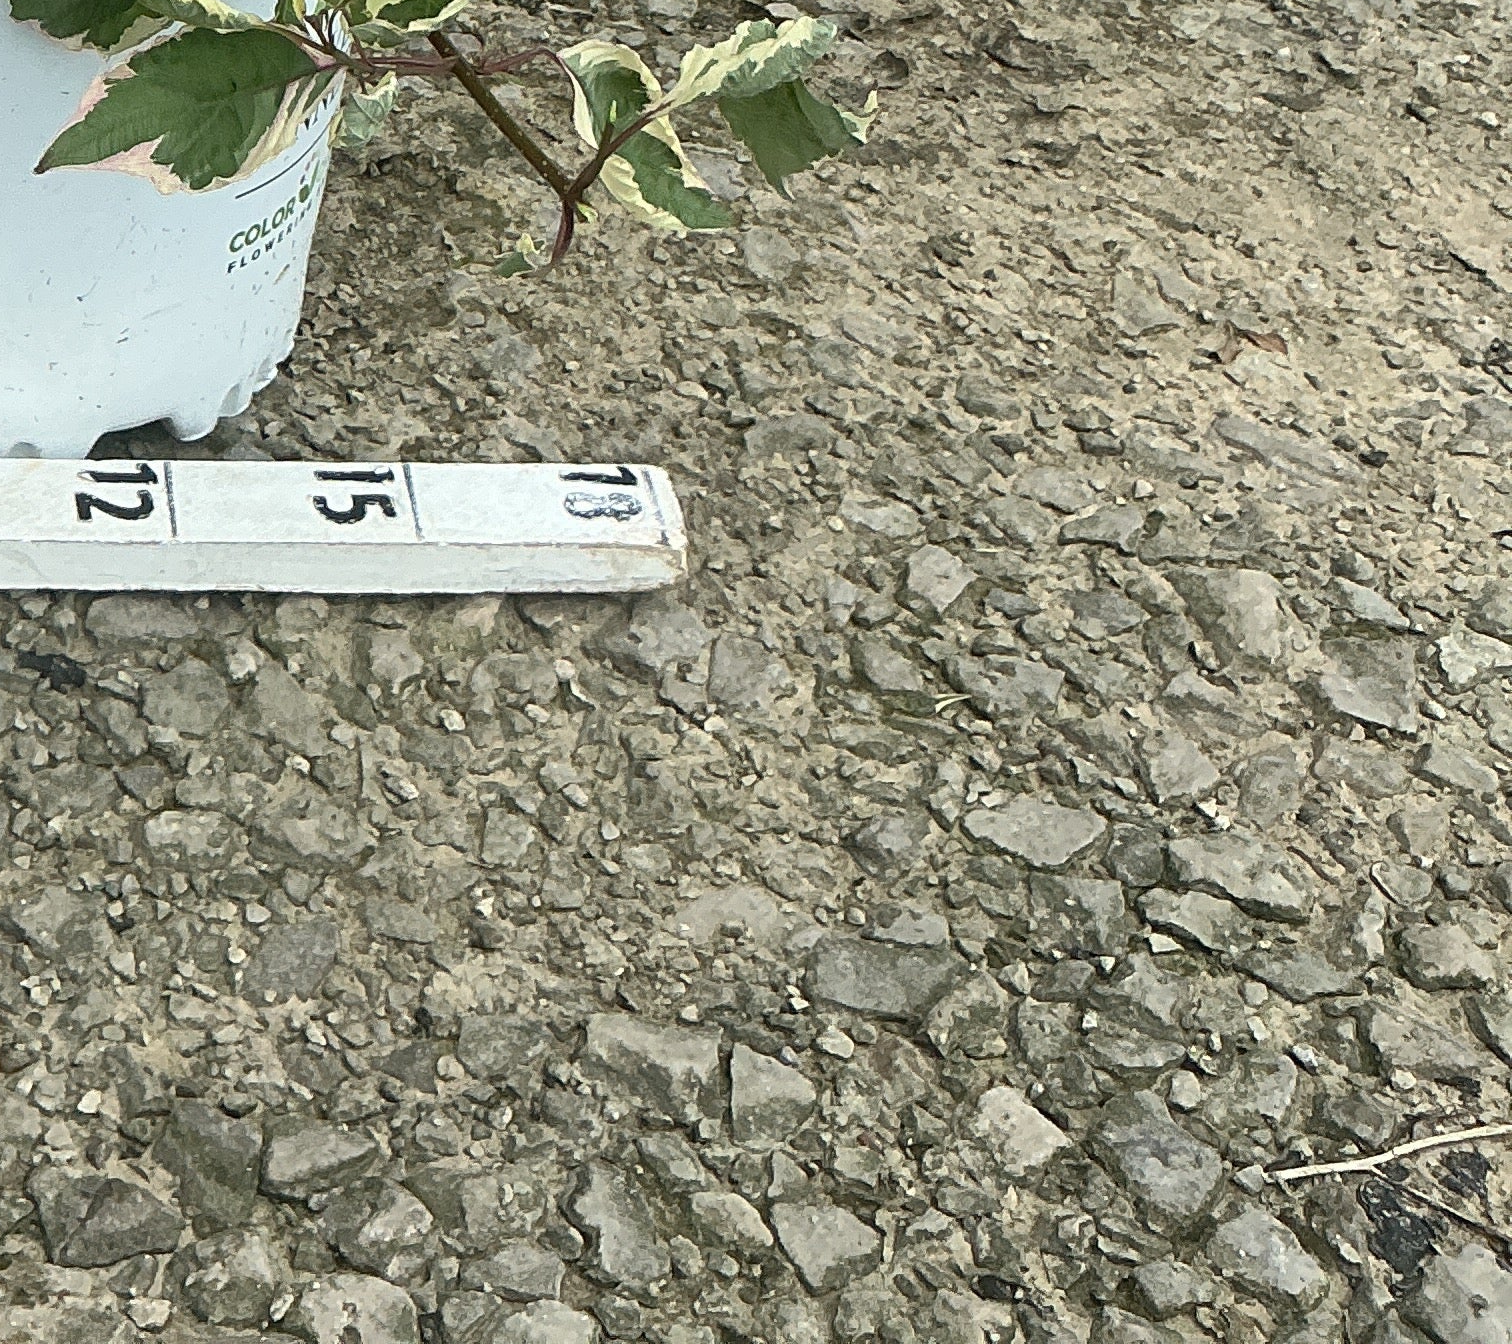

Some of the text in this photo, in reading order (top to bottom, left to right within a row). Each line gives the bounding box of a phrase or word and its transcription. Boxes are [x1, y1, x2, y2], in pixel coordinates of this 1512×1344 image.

[229, 196, 297, 253] COLOR
[75, 462, 159, 522] 12
[313, 465, 398, 524] 15
[558, 465, 644, 522] 18
